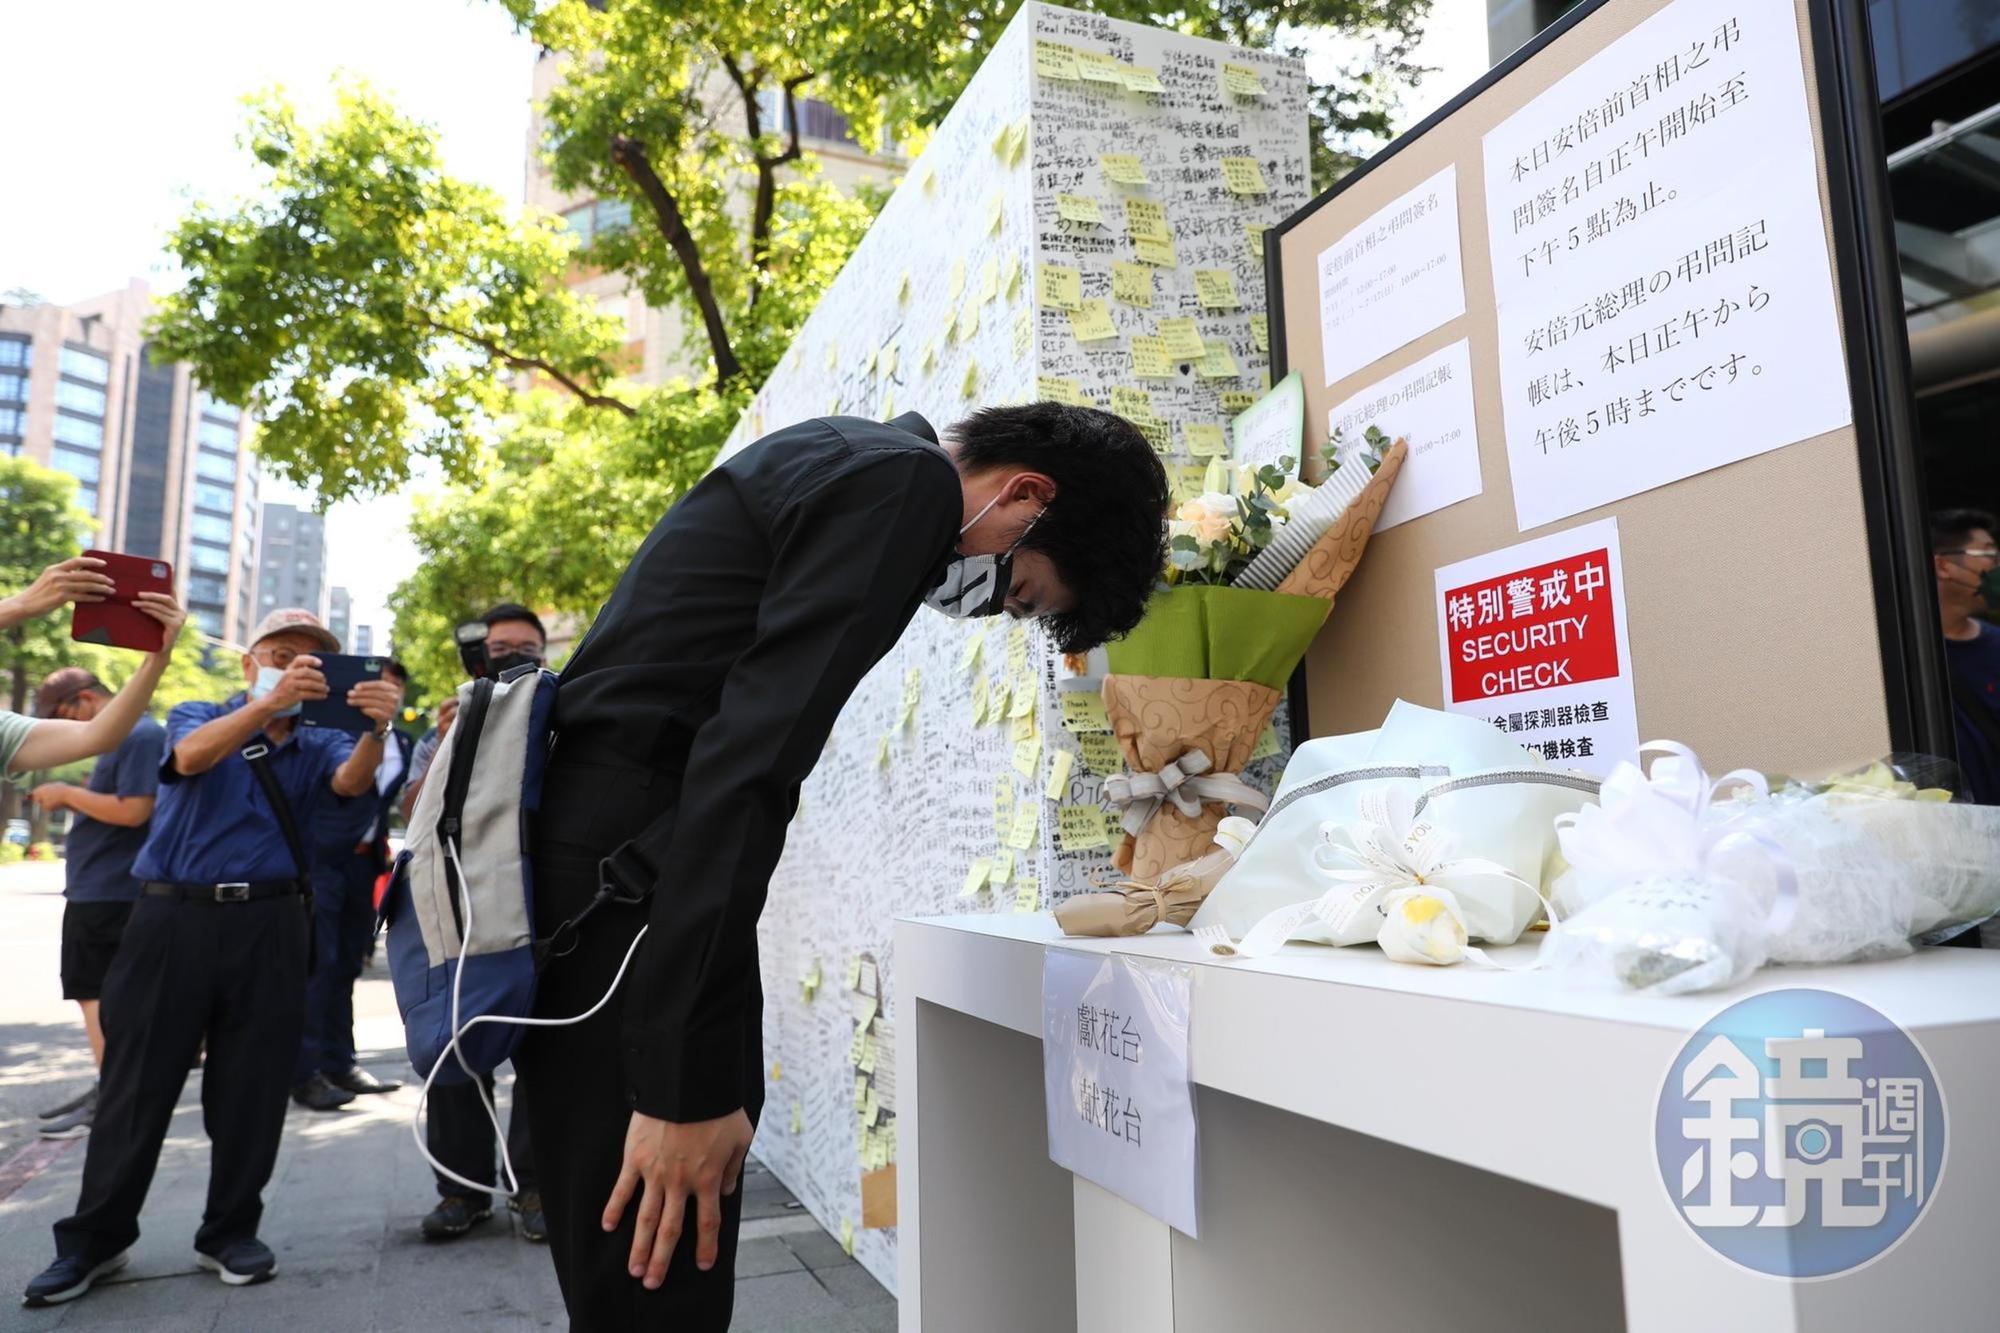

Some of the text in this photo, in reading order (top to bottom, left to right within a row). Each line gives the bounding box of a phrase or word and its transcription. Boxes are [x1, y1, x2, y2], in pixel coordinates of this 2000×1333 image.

[1036, 20, 1059, 34] Real
[1508, 17, 1742, 185] 本日安倍前首相之弔
[1512, 71, 1750, 235] 問簽名自正午開始至
[1516, 181, 1677, 278] 下午5點為止。
[1524, 219, 1769, 358] 安倍元総理の弔問記
[1526, 284, 1771, 408] 帳は、本日正午から
[1135, 378, 1191, 400] Thank you
[1534, 352, 1762, 456] 午後5時までです。
[1448, 560, 1605, 632] 特別警戒中
[1462, 615, 1589, 662] SECURITY
[1481, 658, 1572, 696] CHECK
[1483, 701, 1609, 733] 金屬探測器檢查
[1520, 736, 1594, 761] 機検査
[1077, 1002, 1142, 1064] 獻花台
[1079, 1078, 1142, 1148] 献花台
